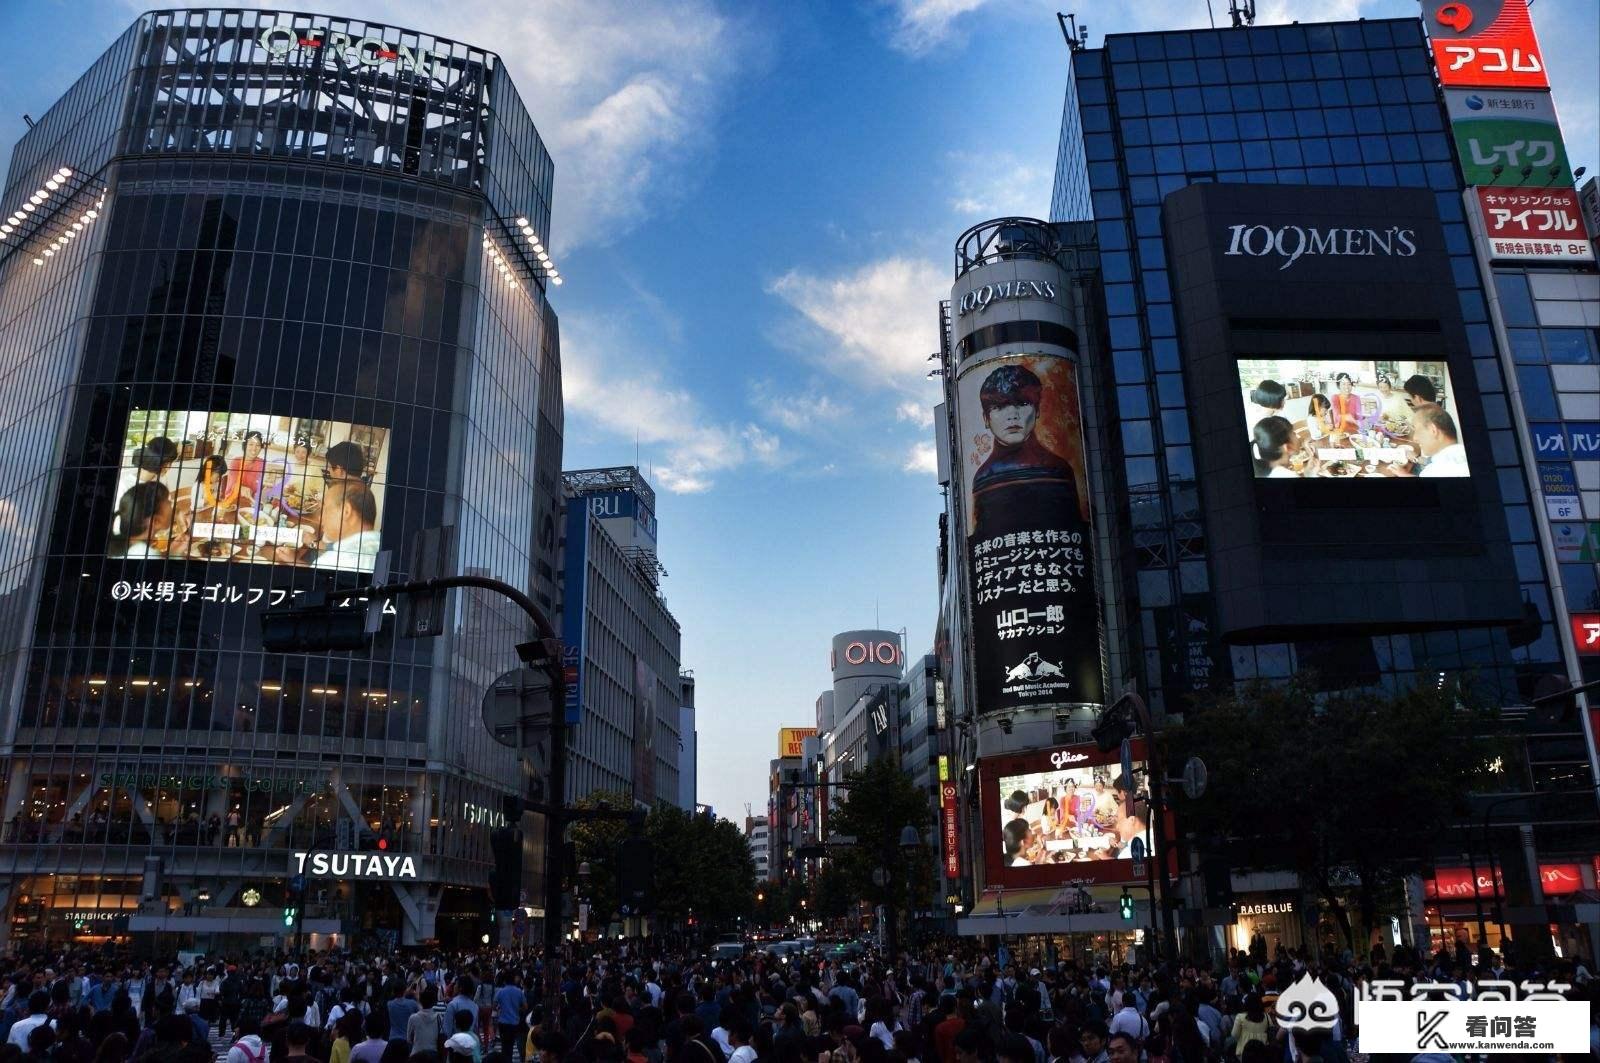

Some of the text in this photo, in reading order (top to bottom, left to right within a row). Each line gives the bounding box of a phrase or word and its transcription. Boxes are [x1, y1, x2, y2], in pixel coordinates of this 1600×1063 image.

[1445, 46, 1542, 72] アコム
[1487, 98, 1535, 110] 新生銀行
[1467, 138, 1556, 167] レイク
[1486, 194, 1572, 206] キャッシングなら
[1488, 208, 1578, 231] アイフル
[1495, 242, 1587, 256] 新規会員募集中 8F
[1536, 433, 1600, 451] レオパレ
[1558, 507, 1571, 517] 6F
[974, 529, 1082, 557] 未来の音楽を作るの
[975, 546, 1084, 573] はミュージシャンでも
[977, 562, 1085, 589] メディアでもなくて
[977, 578, 1077, 605] リスナーだと思う。
[996, 604, 1065, 630] 山口一郎
[997, 623, 1065, 641] サカナクション
[1013, 684, 1025, 692] Bull
[1043, 681, 1070, 689] Academy
[1018, 688, 1053, 698] Tokyo 2014
[870, 702, 888, 735] ZAR
[1050, 751, 1089, 769] Glico
[100, 773, 327, 793] STARBUCKS COFFEE
[294, 852, 417, 877] TSUTAYA
[1240, 902, 1293, 915] RAGEBLUE
